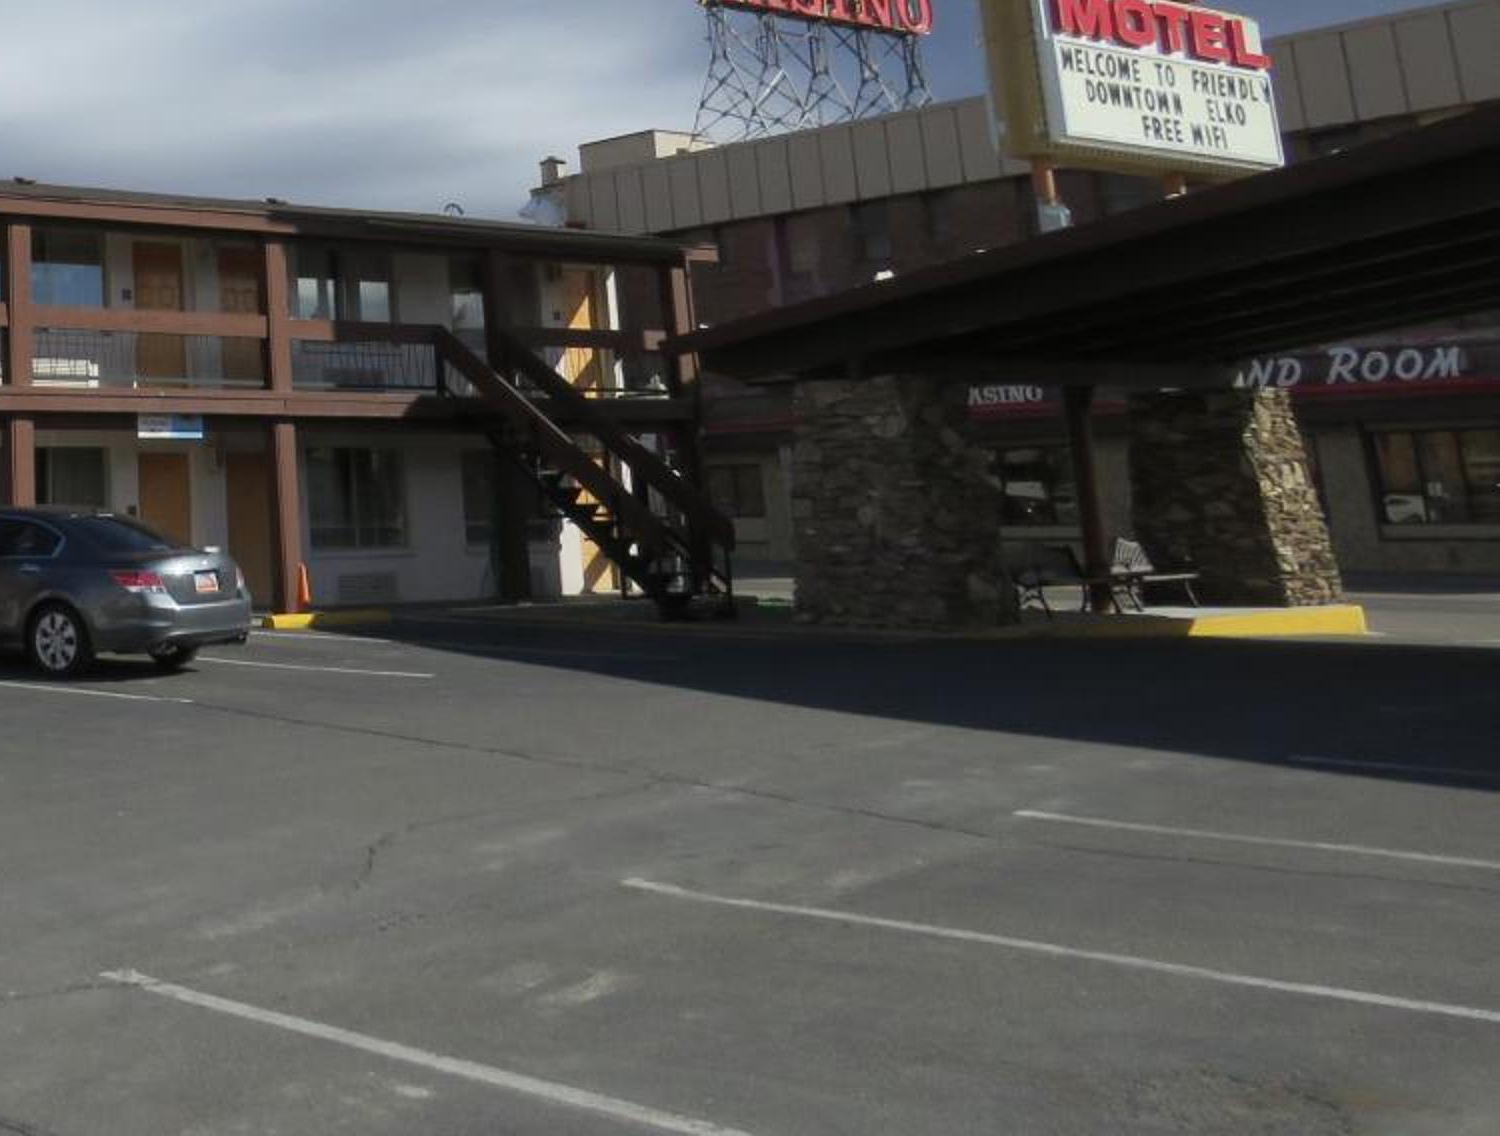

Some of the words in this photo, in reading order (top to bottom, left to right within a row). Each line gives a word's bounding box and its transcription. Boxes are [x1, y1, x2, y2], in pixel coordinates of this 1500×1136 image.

[1060, 46, 1140, 82] WELCOME
[1154, 63, 1176, 87] TO
[1190, 69, 1271, 103] FRIENDLY
[1085, 78, 1183, 115] DOWNTOWN
[1206, 98, 1247, 126] ELKO
[1141, 115, 1184, 143] FREE
[1191, 123, 1228, 149] WIFI
[1244, 358, 1301, 386] ND
[1327, 346, 1461, 385] ROOM
[967, 385, 1043, 405] ASINO
